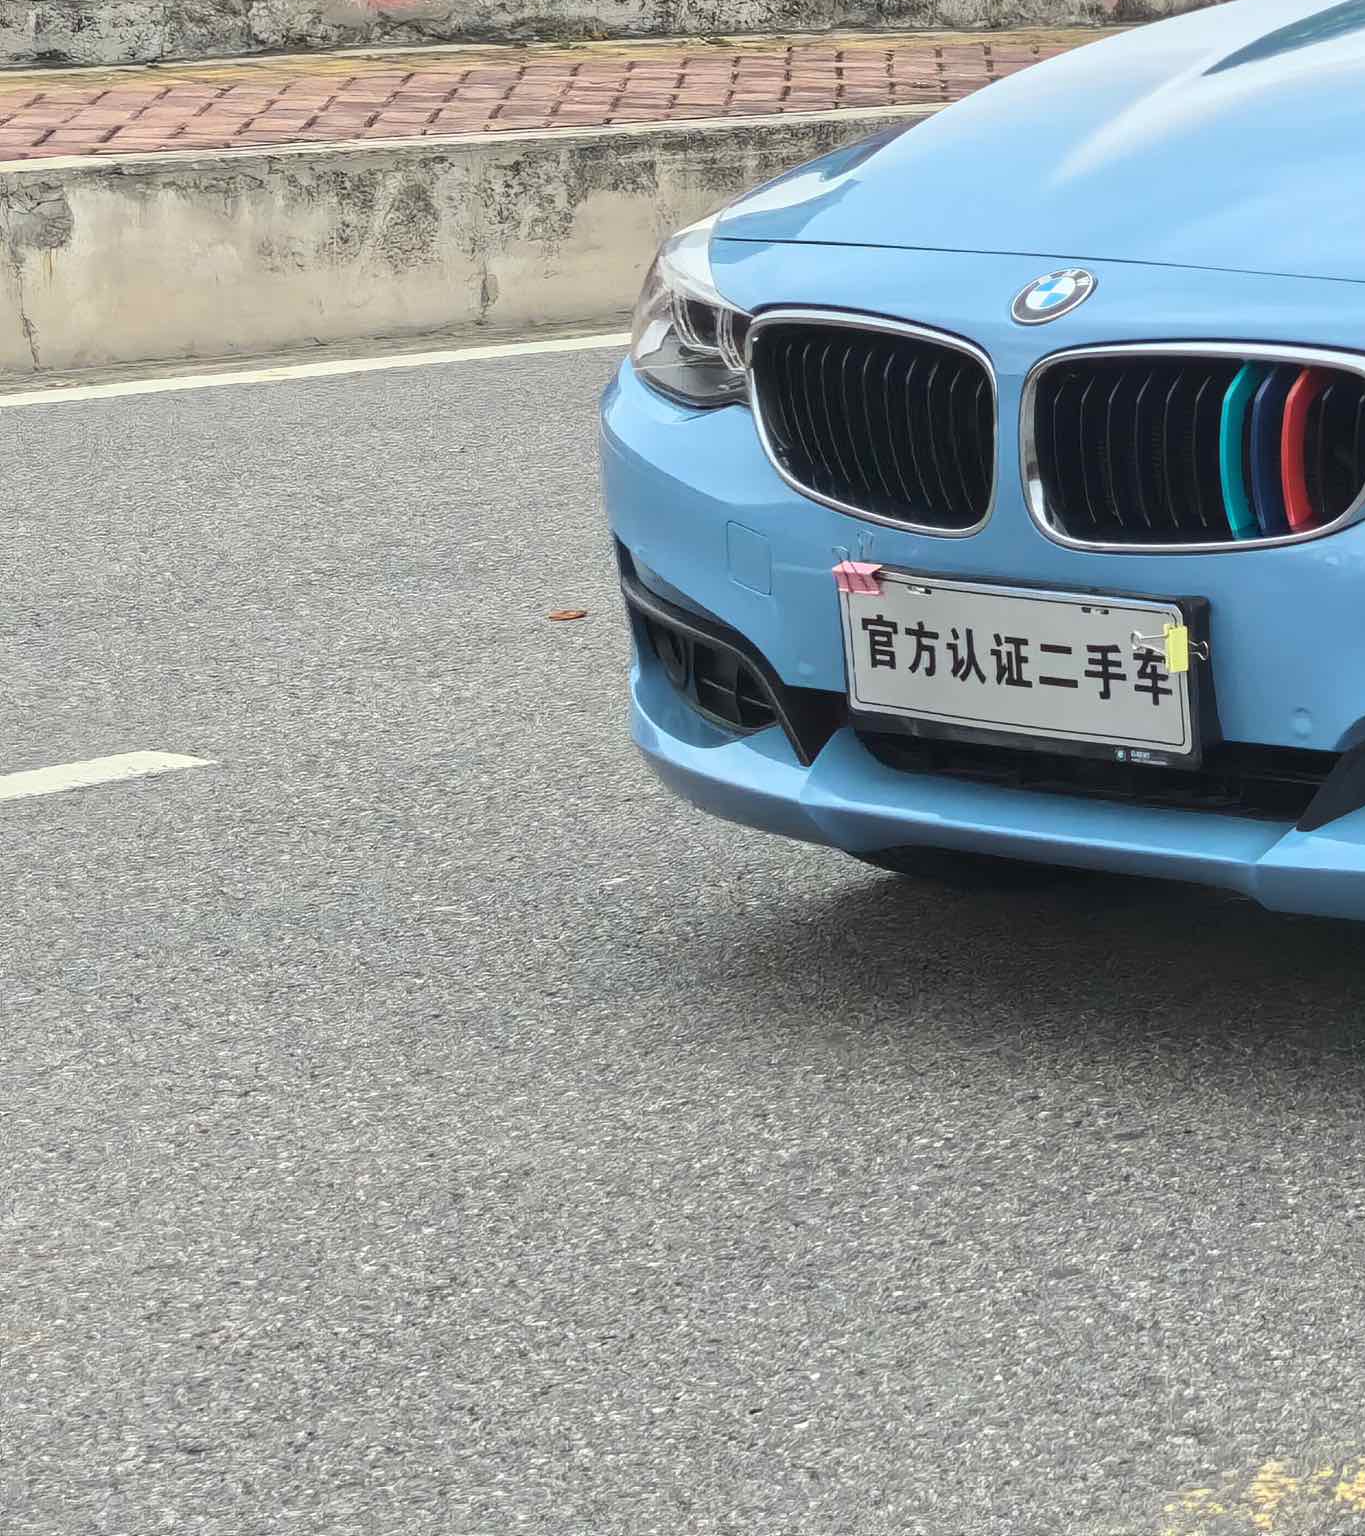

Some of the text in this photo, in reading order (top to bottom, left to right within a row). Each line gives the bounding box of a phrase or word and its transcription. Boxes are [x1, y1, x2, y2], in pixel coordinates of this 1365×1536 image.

[861, 614, 1173, 706] 官方认证二手车
